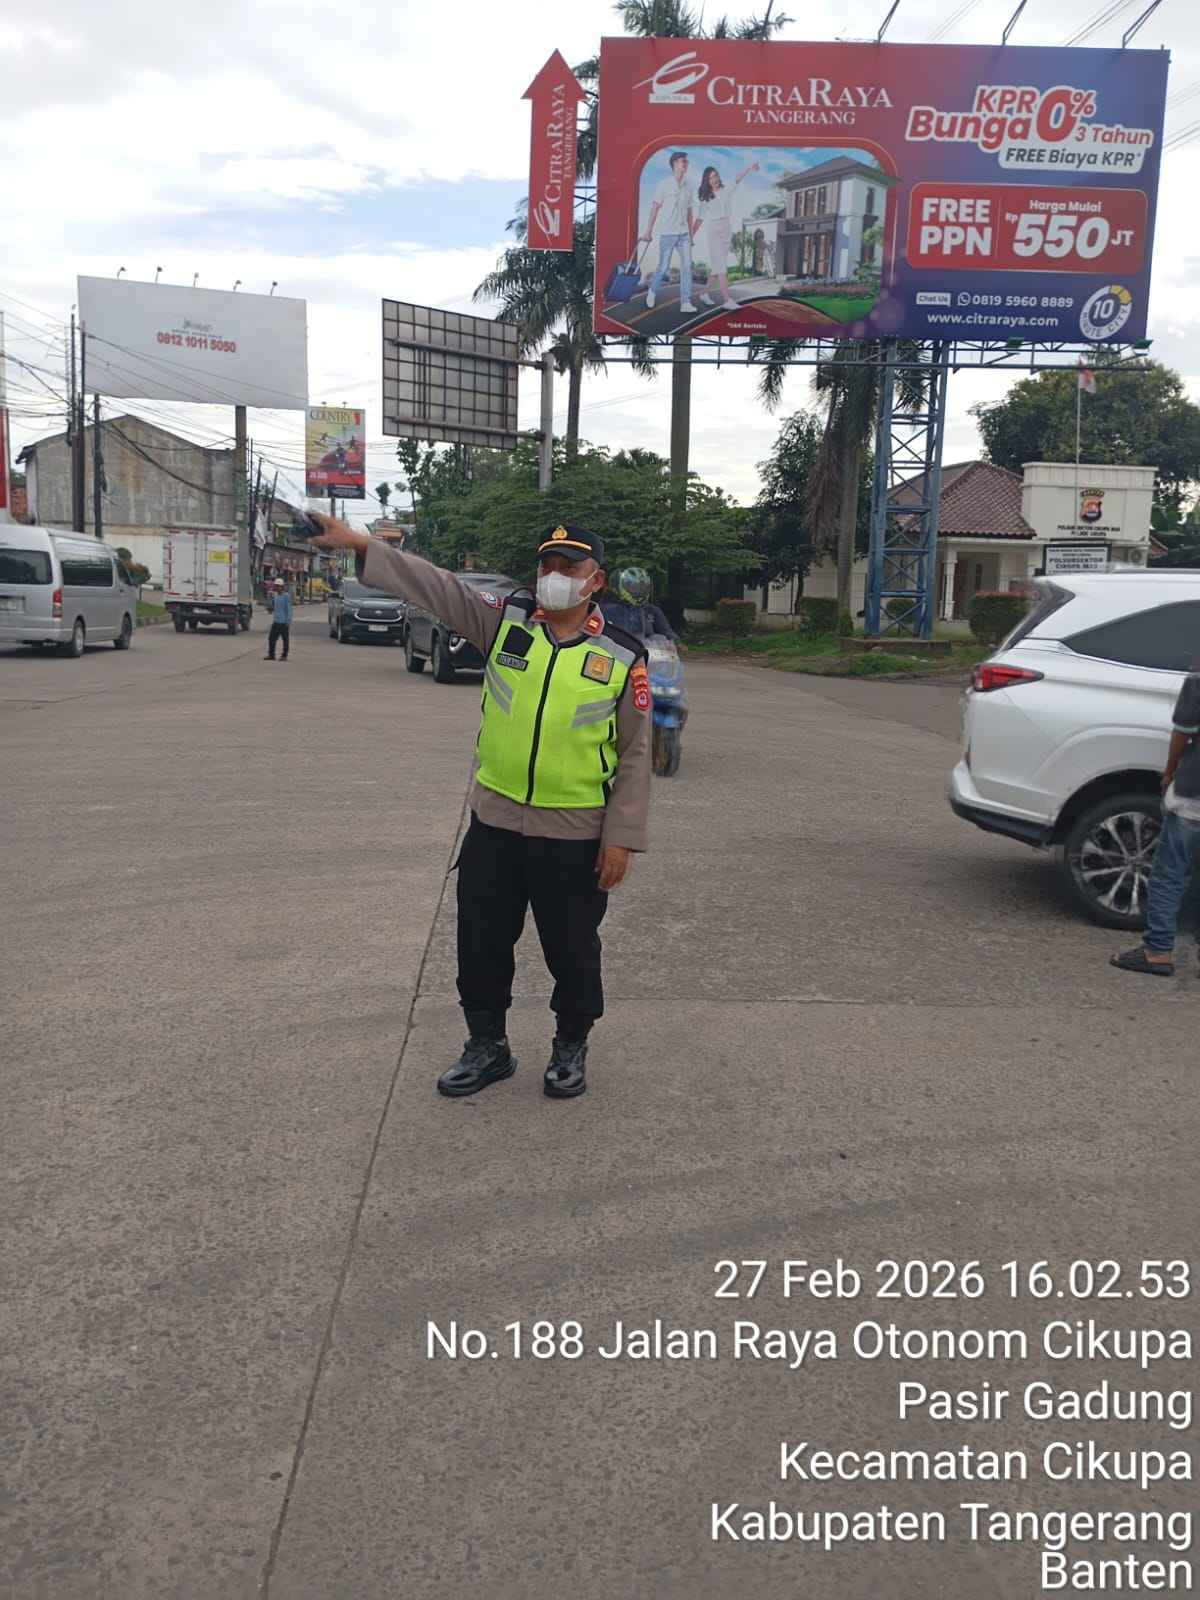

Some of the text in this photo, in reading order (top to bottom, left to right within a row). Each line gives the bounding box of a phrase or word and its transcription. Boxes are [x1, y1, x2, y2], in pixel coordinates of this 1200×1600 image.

[976, 87, 1037, 114] KPR
[743, 109, 856, 125] TANGERANG
[907, 108, 1031, 151] Bunga
[1074, 126, 1152, 145] 3 Tahun
[564, 106, 574, 179] TANGERANG
[1005, 148, 1045, 163] FREE
[1048, 148, 1098, 168] Biaya
[922, 197, 991, 223] FREE
[1029, 199, 1102, 213] Harga Mulai
[919, 226, 993, 255] PPN
[1005, 213, 1134, 259] Rp 550 JT
[972, 295, 1002, 306] 0819
[1005, 295, 1037, 307] 5960
[1041, 296, 1074, 307] 8889
[1093, 299, 1114, 320] 10
[927, 312, 1059, 327] www.citraraya.com
[1107, 308, 1129, 332] CITY
[157, 331, 183, 346] 0812
